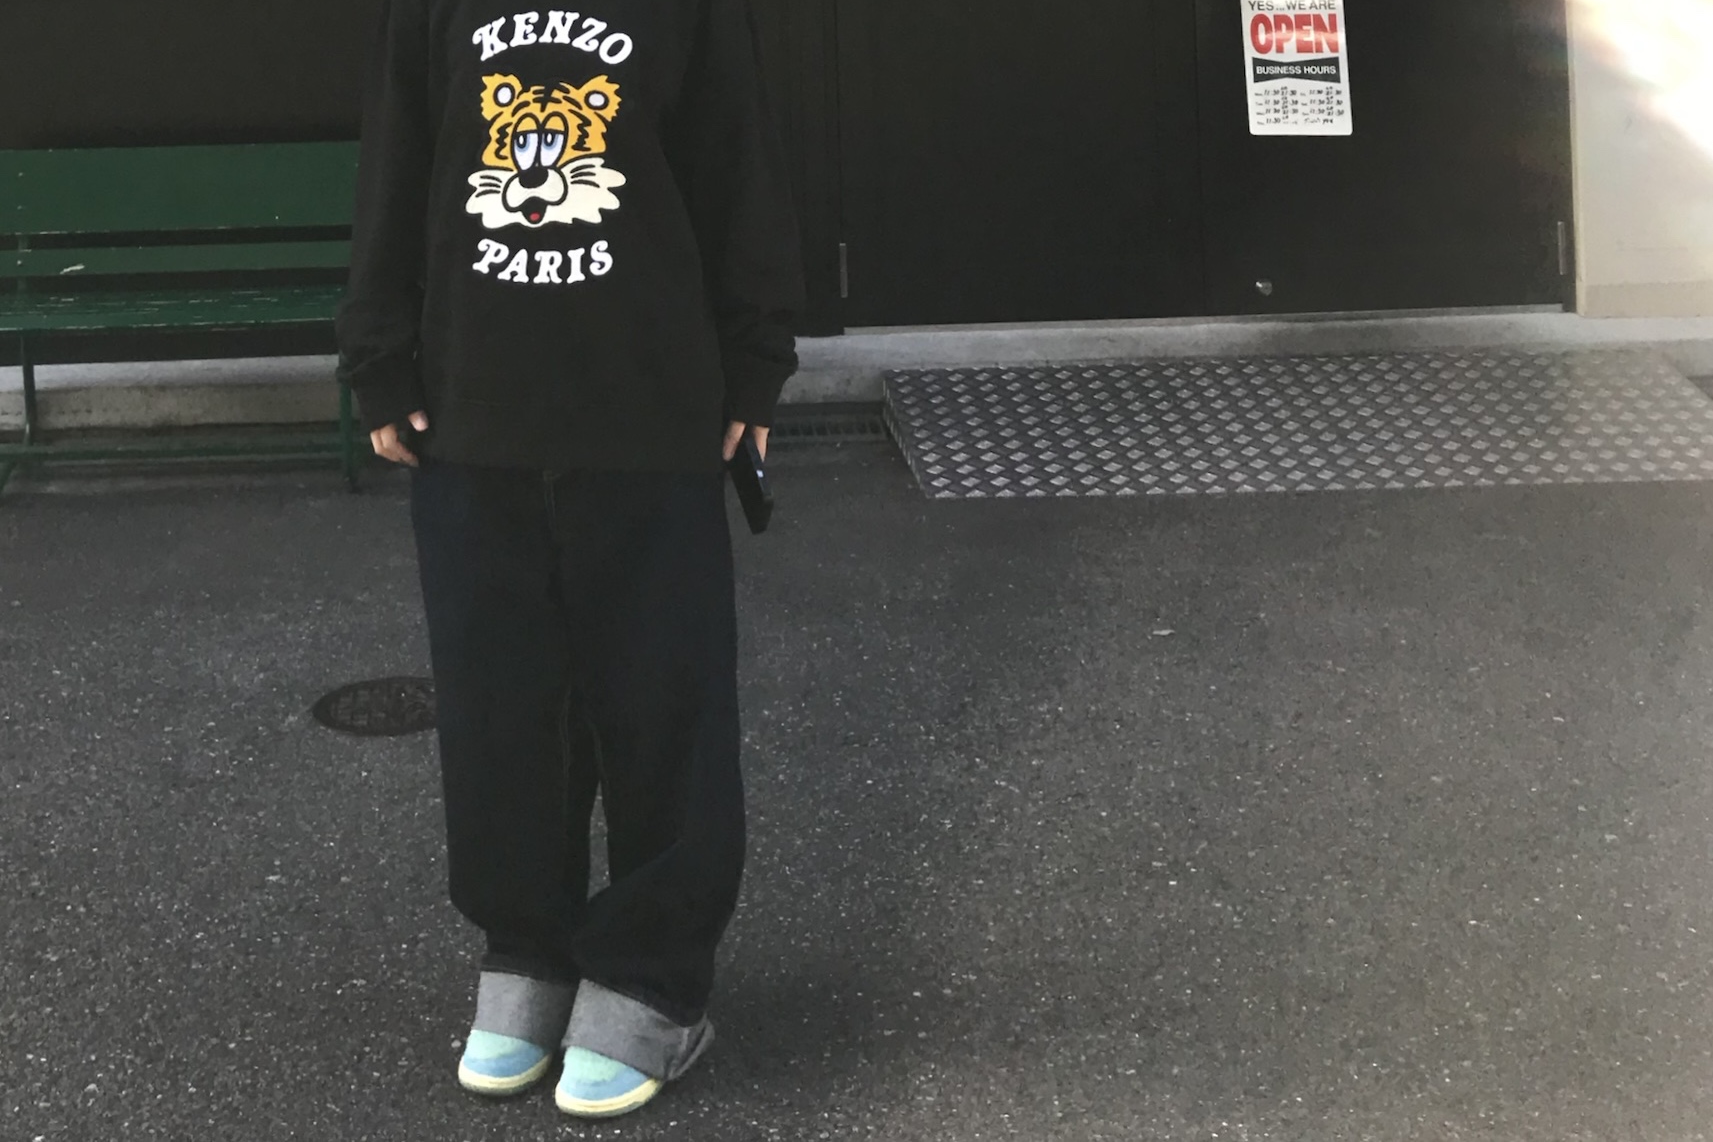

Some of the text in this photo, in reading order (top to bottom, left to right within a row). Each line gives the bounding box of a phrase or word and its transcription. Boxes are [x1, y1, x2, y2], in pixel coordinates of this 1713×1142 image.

[1310, 0, 1336, 10] ARE
[472, 10, 634, 65] KENZO
[1250, 13, 1339, 55] OPEN
[1256, 65, 1336, 75] BUSINESS HOURS
[472, 238, 614, 284] PARIS
